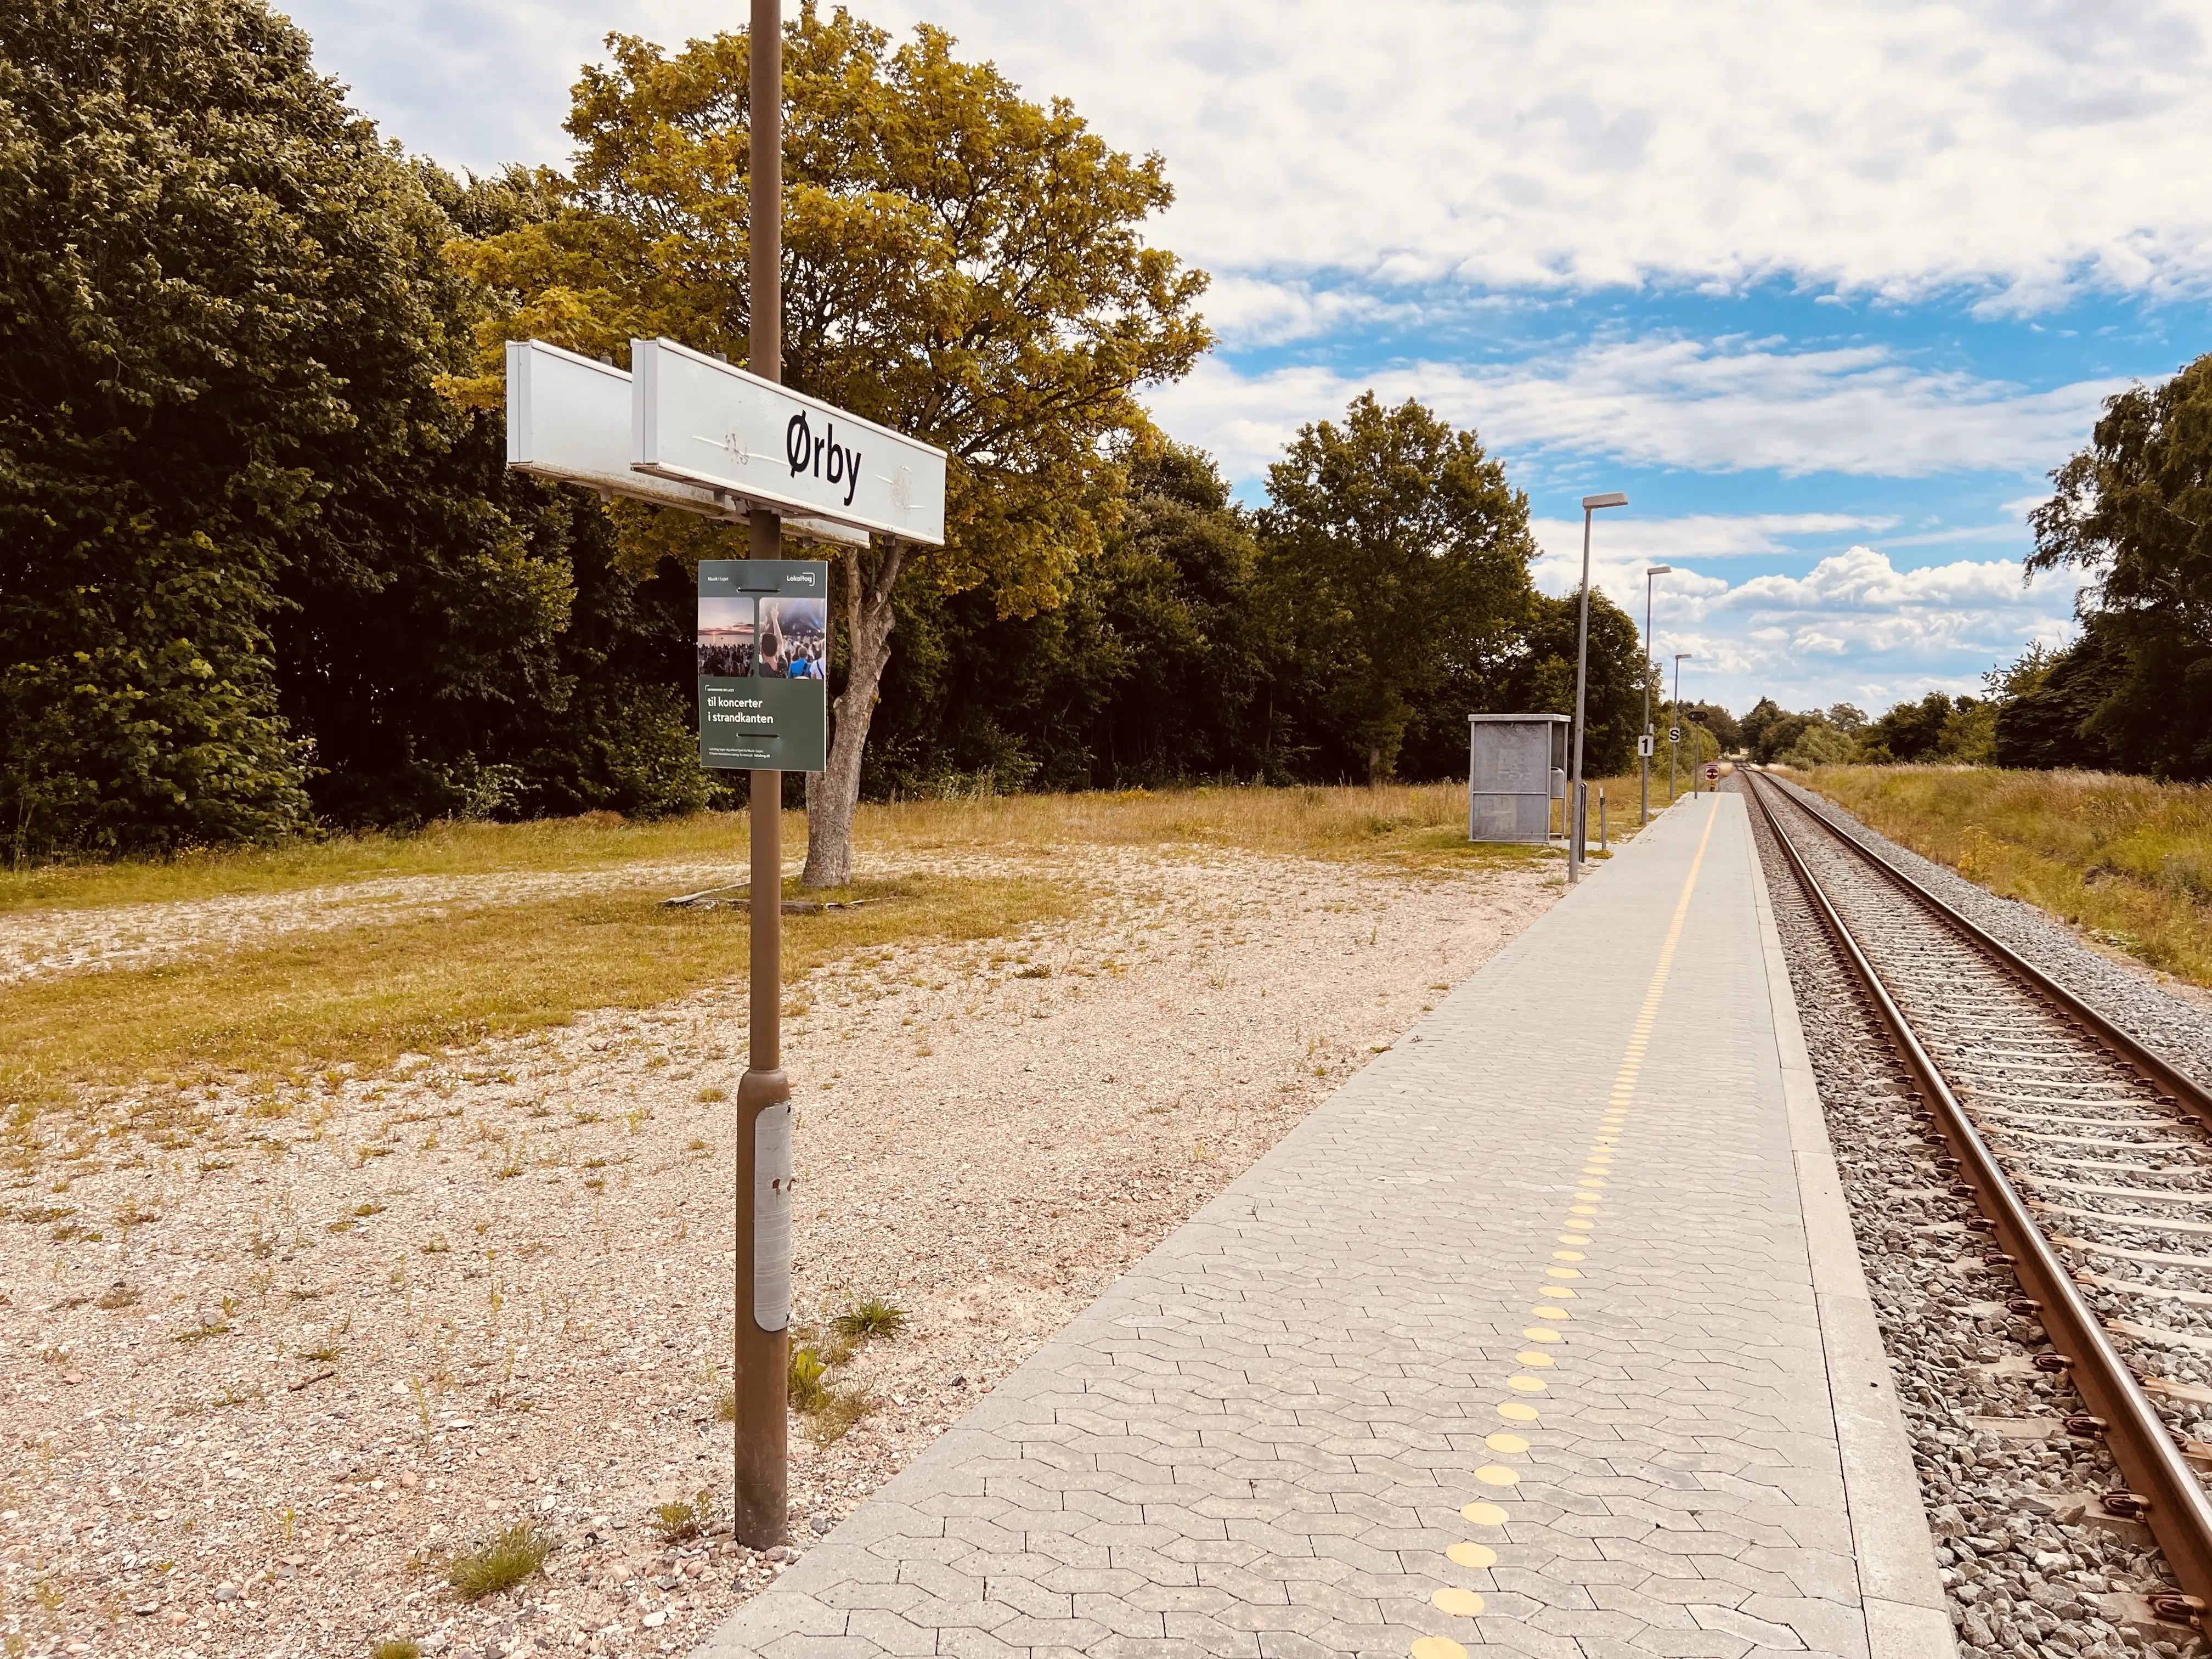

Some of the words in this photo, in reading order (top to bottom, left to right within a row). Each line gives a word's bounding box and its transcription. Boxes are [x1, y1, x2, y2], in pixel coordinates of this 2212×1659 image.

[787, 409, 861, 506] Ørby
[786, 575, 812, 583] Lokaltog
[707, 696, 716, 707] til
[718, 696, 763, 708] koncerter
[708, 712, 711, 721] i
[712, 712, 774, 724] strandkanten
[1669, 730, 1679, 741] S
[1641, 738, 1648, 754] 1
